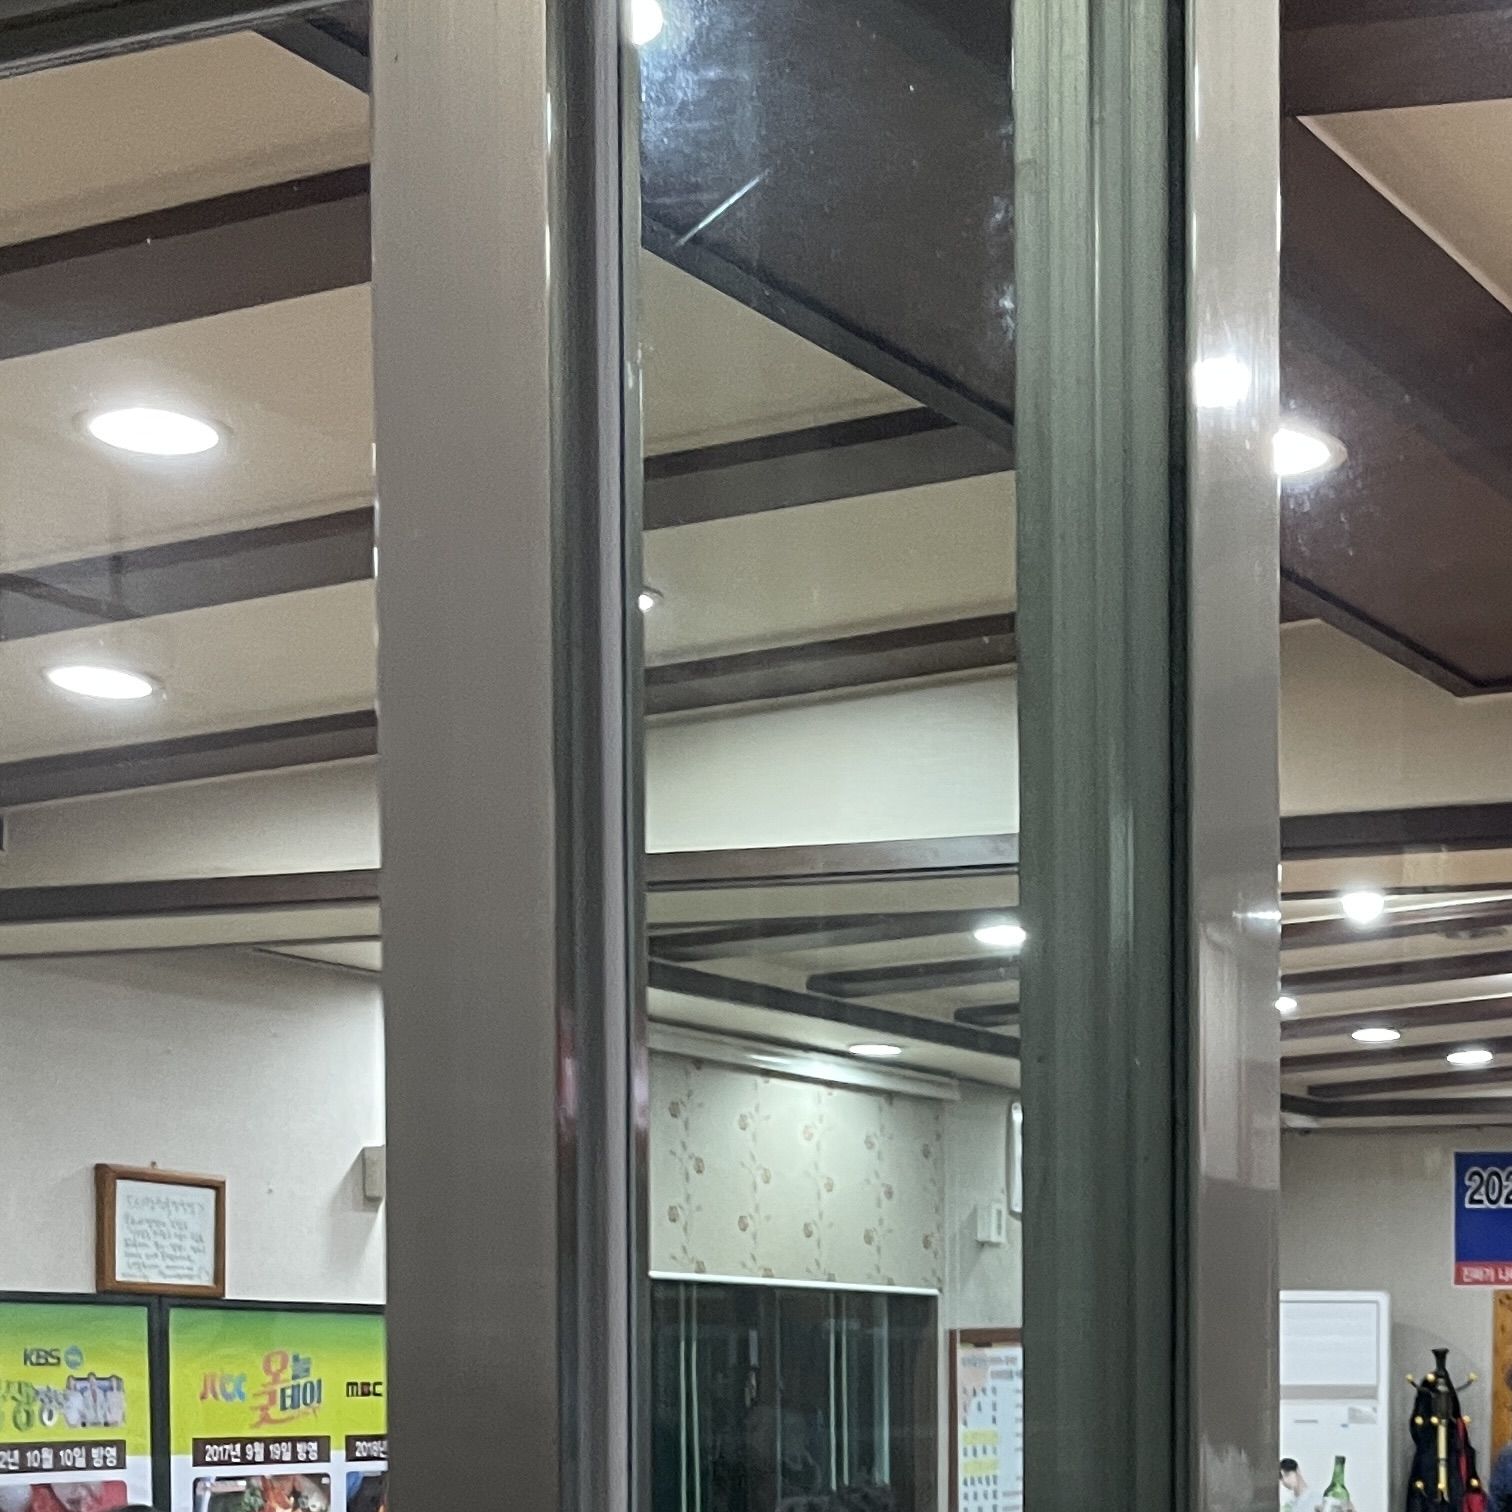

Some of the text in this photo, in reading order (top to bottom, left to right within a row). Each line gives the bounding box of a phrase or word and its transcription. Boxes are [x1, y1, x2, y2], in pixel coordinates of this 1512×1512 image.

[23, 1347, 61, 1367] KBS
[345, 1381, 383, 1398] MBC
[59, 1445, 87, 1469] 10일
